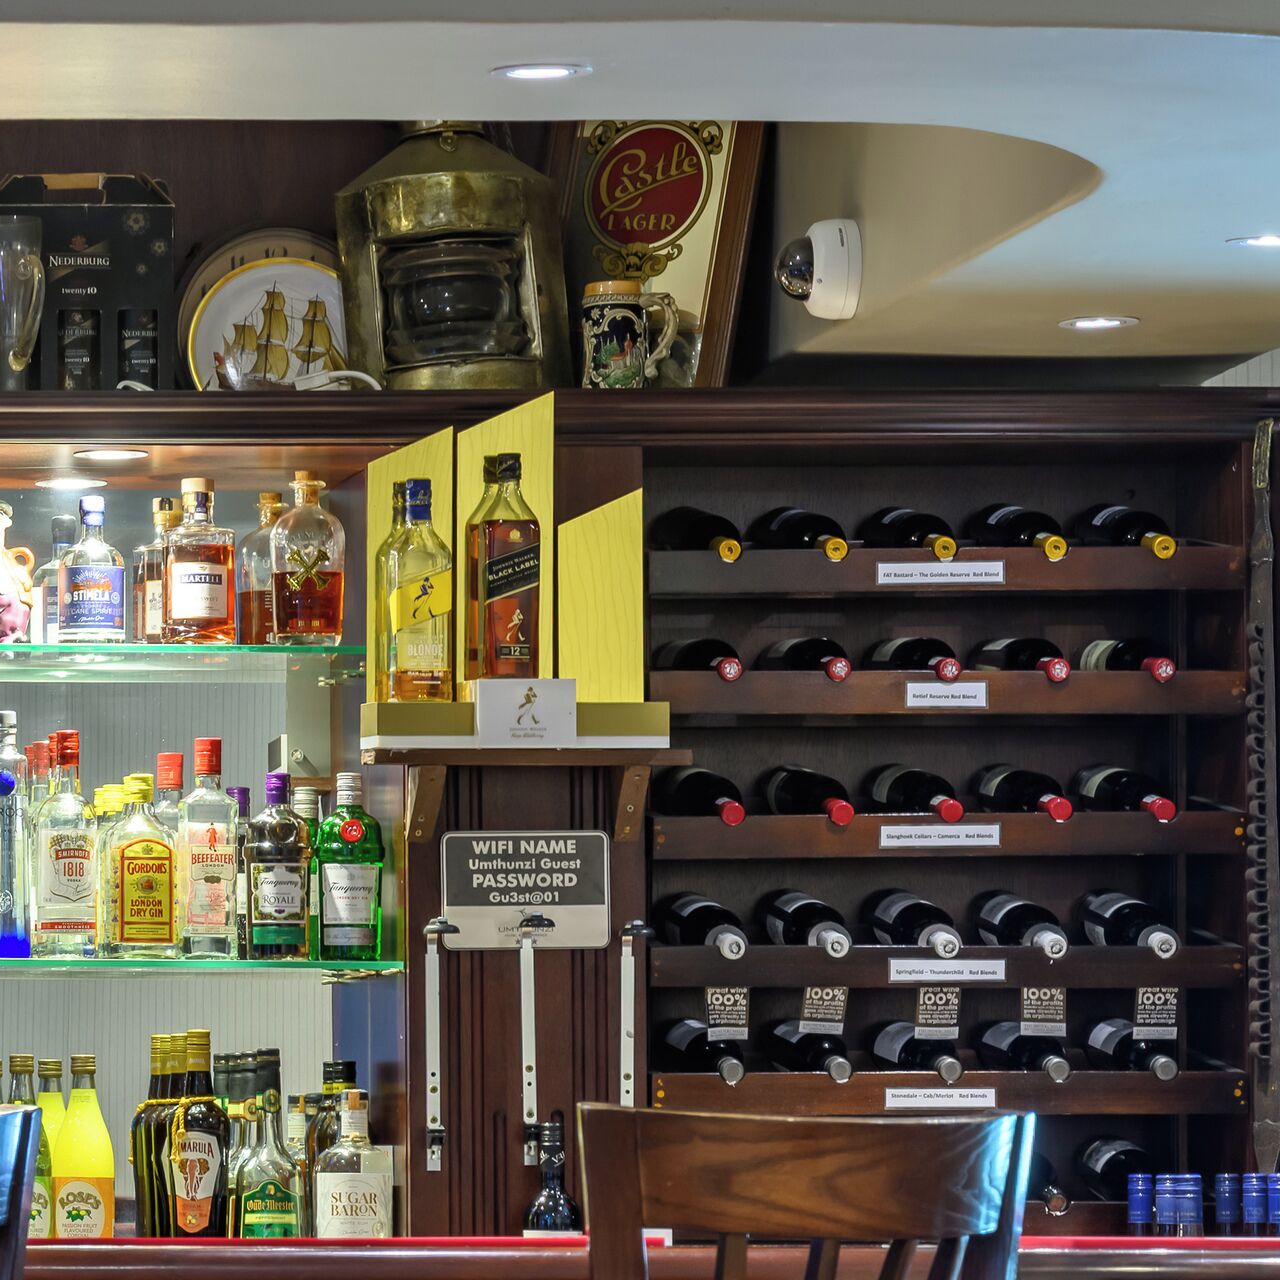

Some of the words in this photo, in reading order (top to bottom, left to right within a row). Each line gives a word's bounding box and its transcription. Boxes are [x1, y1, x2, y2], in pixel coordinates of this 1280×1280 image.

[599, 142, 698, 218] Castle
[607, 211, 677, 233] LAGER
[49, 255, 111, 268] NEDERBURG
[61, 286, 97, 297] twenty10
[487, 567, 513, 582] BLACK
[513, 558, 539, 575] LABEL
[73, 591, 110, 601] STIMELA
[406, 643, 444, 657] BLONDE
[510, 647, 521, 657] 12
[472, 840, 514, 855] WIFI
[520, 839, 577, 854] NAME
[57, 850, 89, 858] SMIRNOFF
[191, 853, 235, 866] BEEFEATER
[63, 861, 84, 877] 1818
[127, 861, 167, 876] GORDON'S
[468, 858, 536, 871] Umthunzi
[540, 857, 581, 870] Guest
[259, 877, 300, 888] Tanqueray
[472, 872, 578, 888] PASSWORD
[329, 881, 373, 894] Tanqueray
[130, 899, 163, 907] LONDON
[489, 891, 559, 905] Gu3st@01
[130, 908, 147, 918] DRY
[148, 907, 164, 918] GIN
[707, 993, 746, 1006] 100%
[805, 987, 845, 1001] 100%
[920, 992, 958, 1005] 100%
[1023, 987, 1064, 1001] 100%
[1138, 992, 1177, 1005] 100%
[330, 1191, 378, 1205] SUGAR
[246, 1199, 266, 1211] Oude
[266, 1199, 295, 1211] Meester
[330, 1204, 379, 1217] BARON
